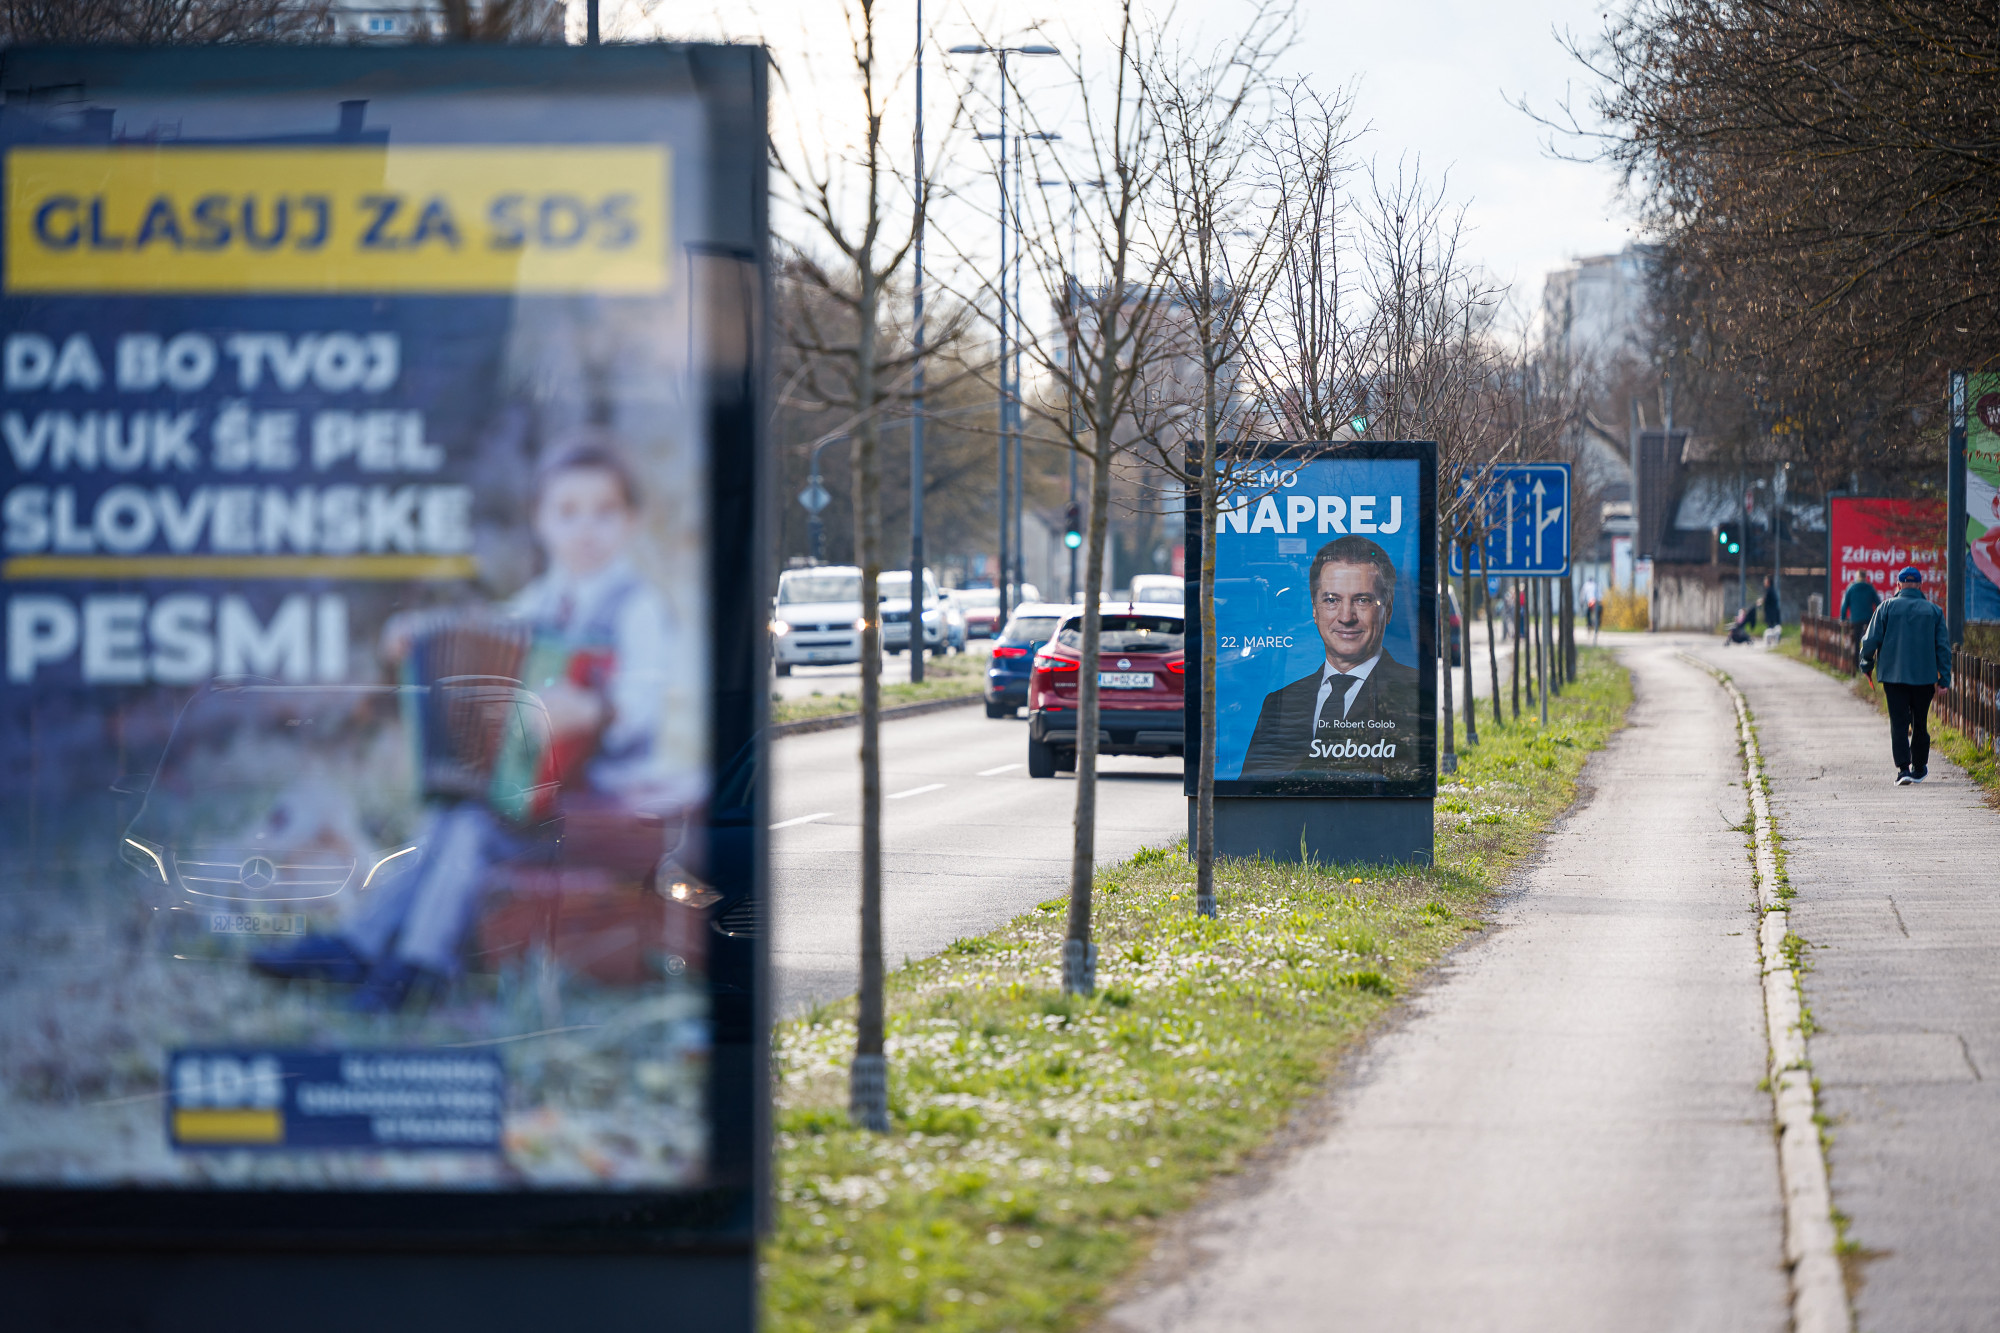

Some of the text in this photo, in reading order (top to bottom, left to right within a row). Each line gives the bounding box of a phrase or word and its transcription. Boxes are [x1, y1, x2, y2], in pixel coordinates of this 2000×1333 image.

[33, 193, 641, 252] GLASUJ ZA SDS
[4, 335, 400, 391] DA BO TVOJ
[3, 399, 444, 470] VNUK ŠE PEL
[4, 485, 474, 554] SLOVENSKE
[1216, 495, 1402, 535] NAPREJ
[1841, 545, 1906, 566] Zdravje
[7, 597, 347, 684] PESMI
[1221, 636, 1293, 648] 22. MAREC
[1318, 719, 1396, 729] Dr. Robert Golob
[1309, 739, 1396, 758] Svoboda
